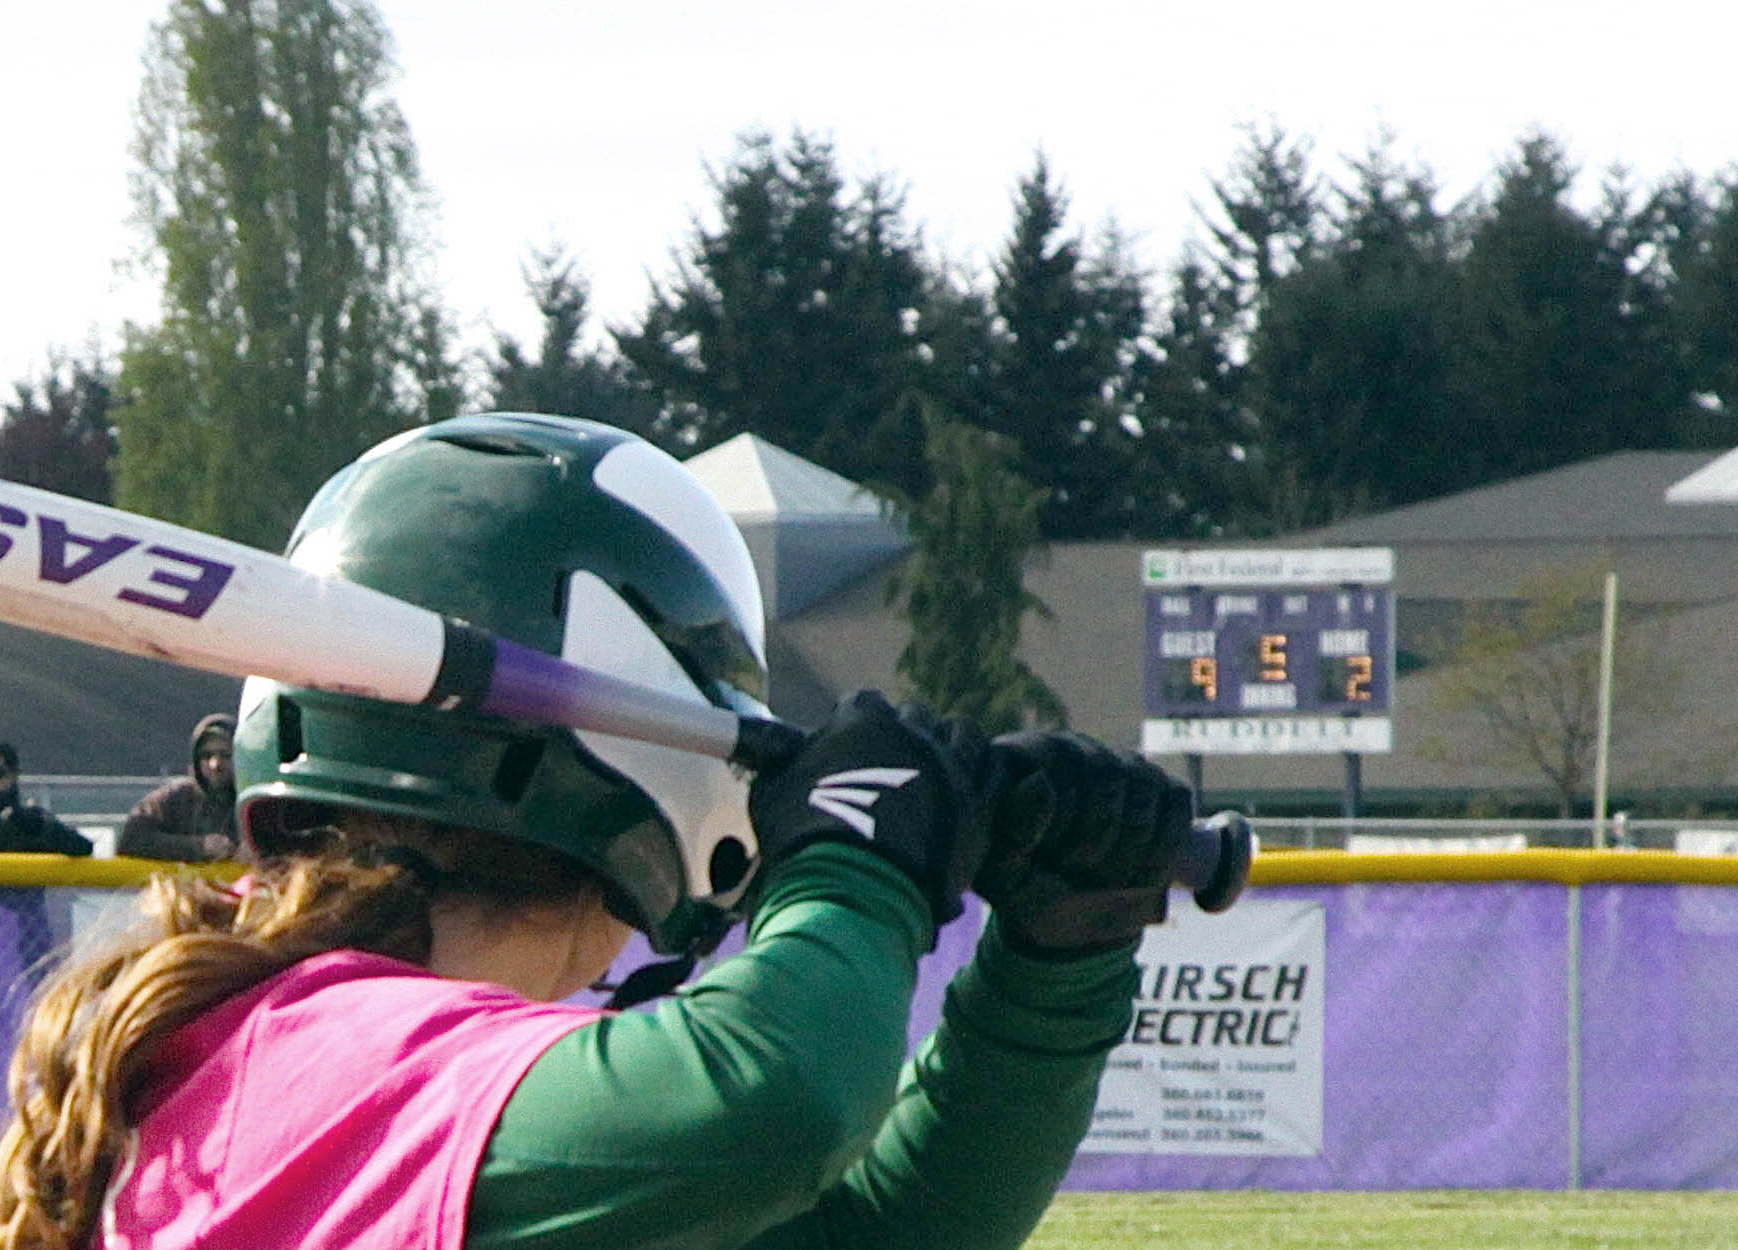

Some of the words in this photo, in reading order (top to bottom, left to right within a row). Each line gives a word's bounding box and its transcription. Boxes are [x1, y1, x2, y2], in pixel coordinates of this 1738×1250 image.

[1191, 657, 1217, 701] 9
[1260, 633, 1288, 681] 5
[1345, 656, 1373, 701] 2
[1131, 1009, 1286, 1046] ECTRIC
